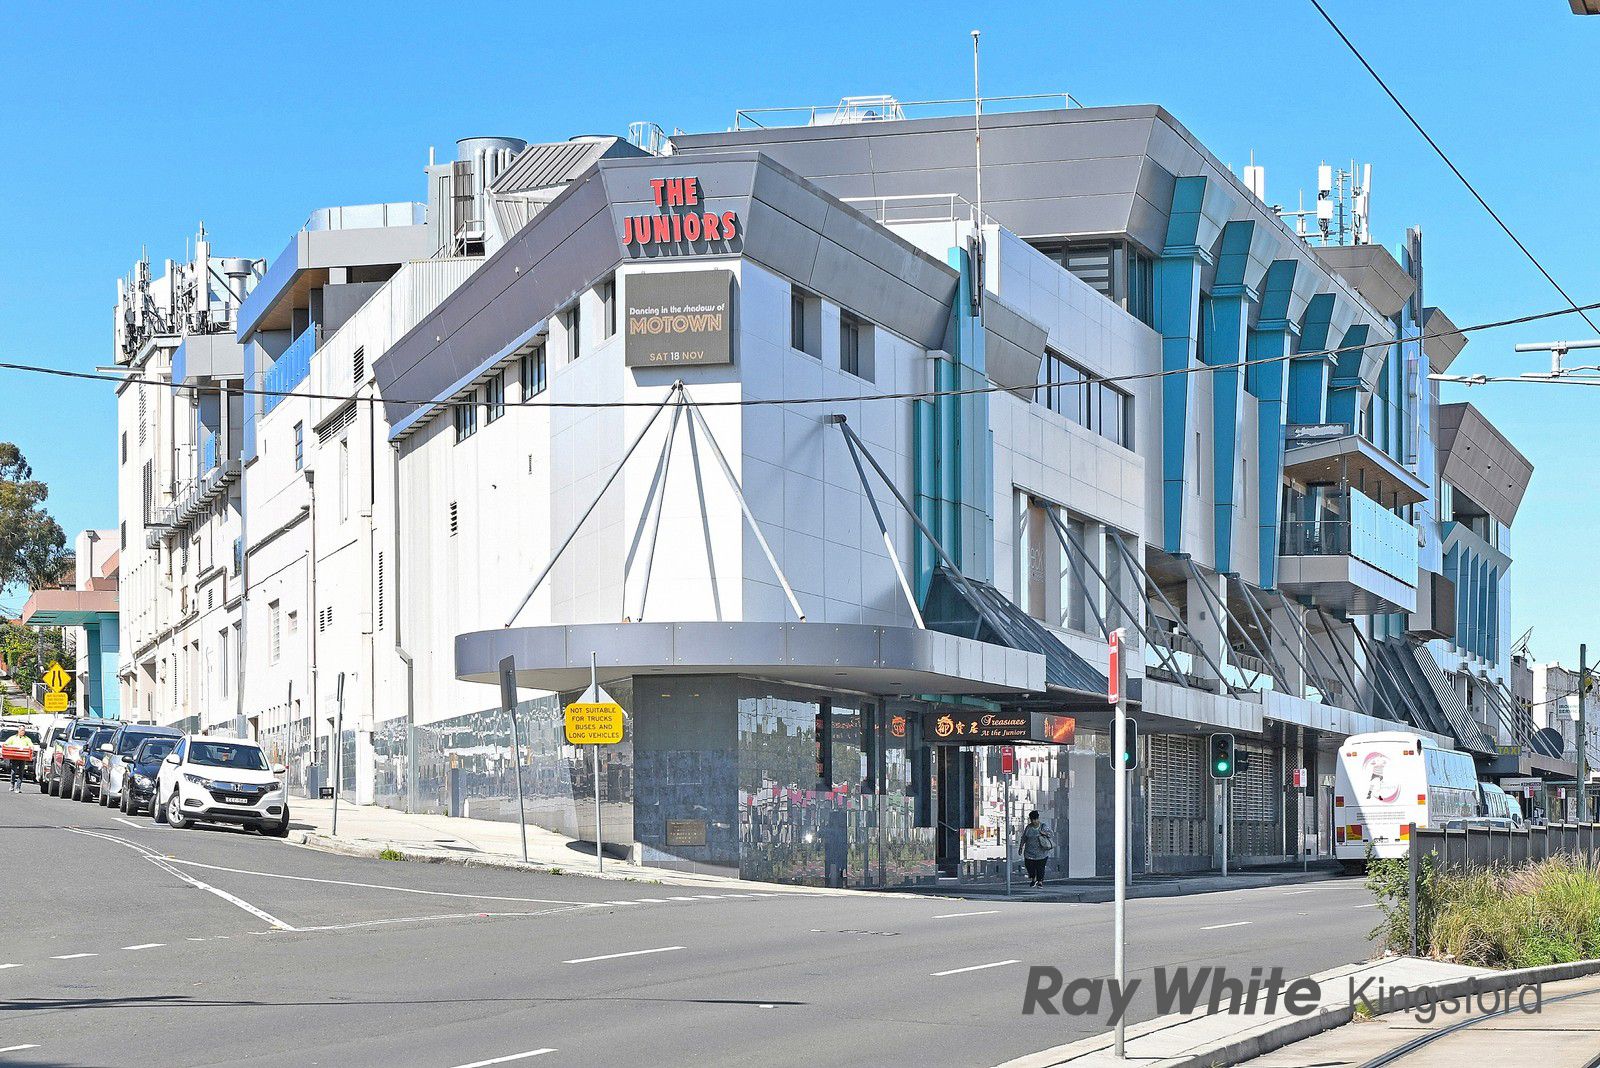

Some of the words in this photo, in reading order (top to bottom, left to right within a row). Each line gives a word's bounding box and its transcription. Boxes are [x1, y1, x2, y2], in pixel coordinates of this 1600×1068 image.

[650, 177, 698, 207] THE
[622, 211, 736, 246] JUNIORS
[629, 306, 660, 316] Dancing
[661, 305, 668, 314] in
[670, 305, 682, 313] the
[683, 304, 715, 313] shadows
[716, 303, 725, 311] of
[629, 314, 722, 335] MOTOWN
[649, 352, 668, 361] SAT
[670, 351, 680, 361] 18
[682, 351, 704, 360] NOV
[991, 728, 1001, 736] the
[1497, 746, 1521, 755] TAXI
